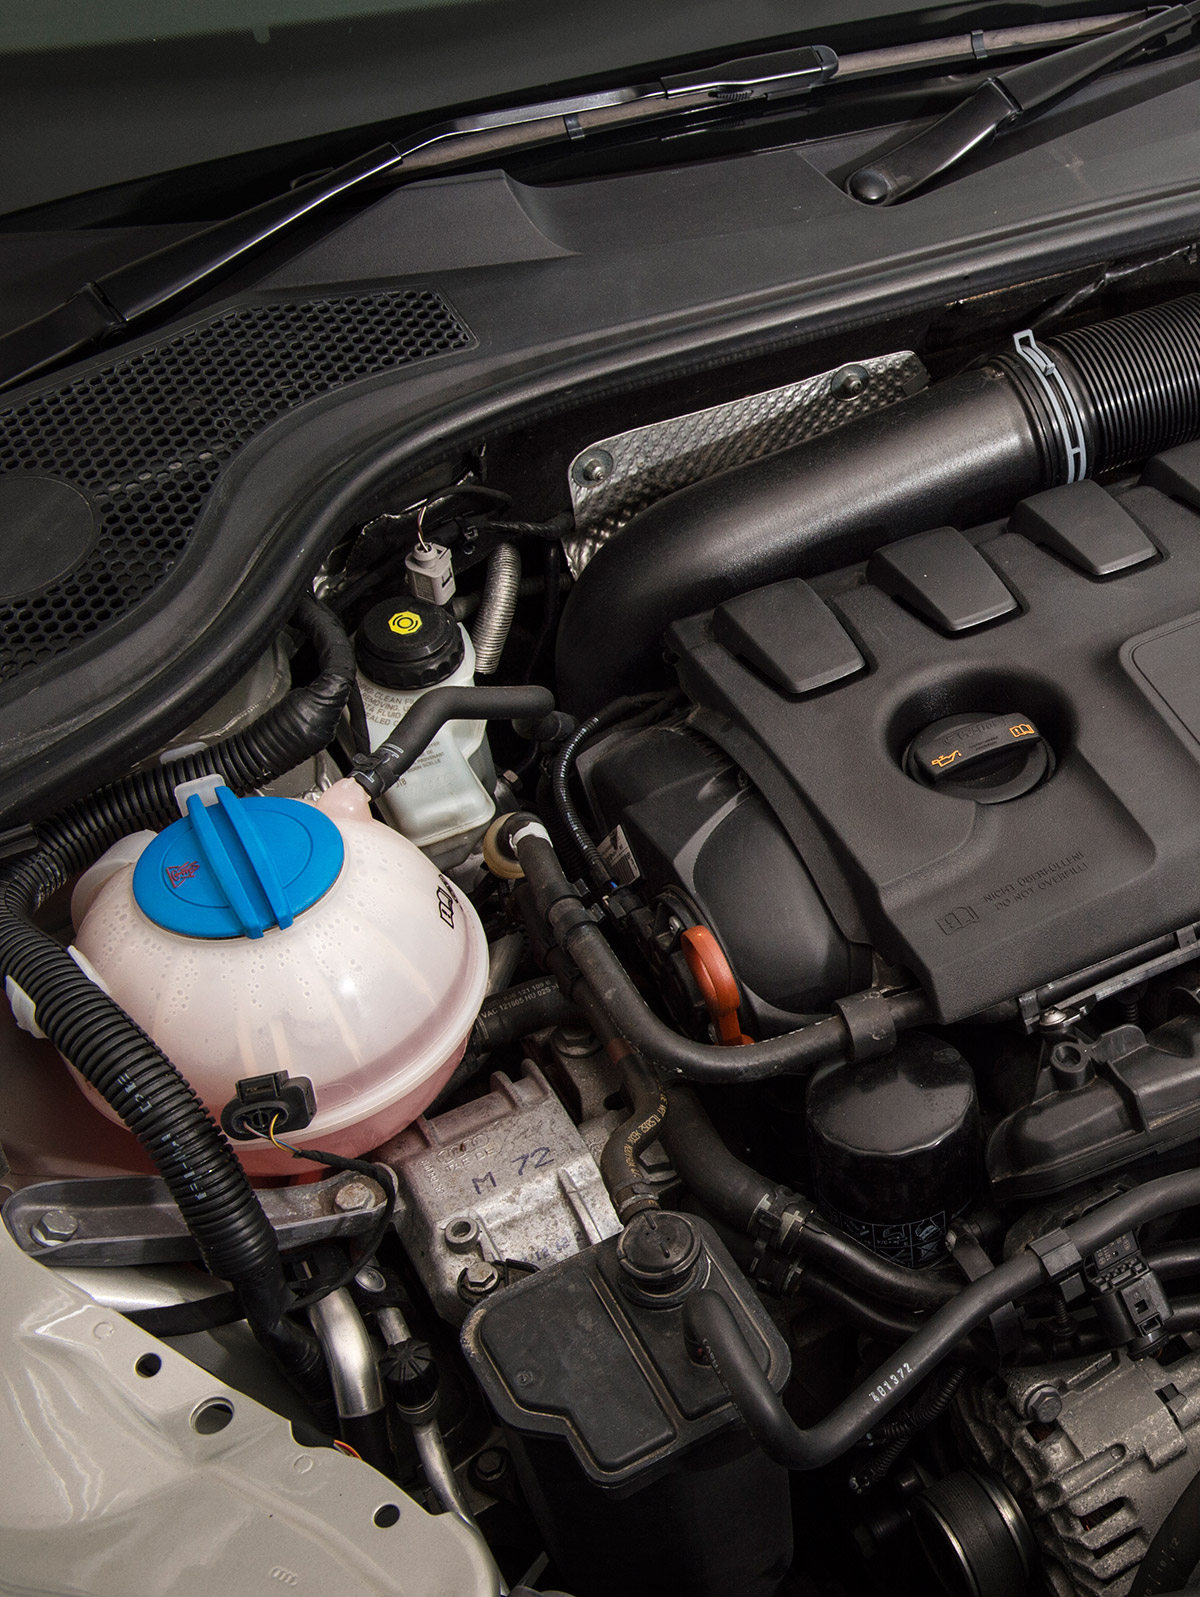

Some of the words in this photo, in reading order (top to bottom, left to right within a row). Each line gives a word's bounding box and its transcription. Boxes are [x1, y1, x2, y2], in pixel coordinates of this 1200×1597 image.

[374, 689, 403, 703] CLEAN
[377, 709, 400, 718] FLUID
[983, 884, 1015, 903] NICHT
[995, 897, 1011, 911] DO
[1013, 886, 1035, 903] NOT
[1038, 862, 1089, 890] OVERFILL!
[472, 1171, 497, 1194] M
[512, 1147, 554, 1175] 72
